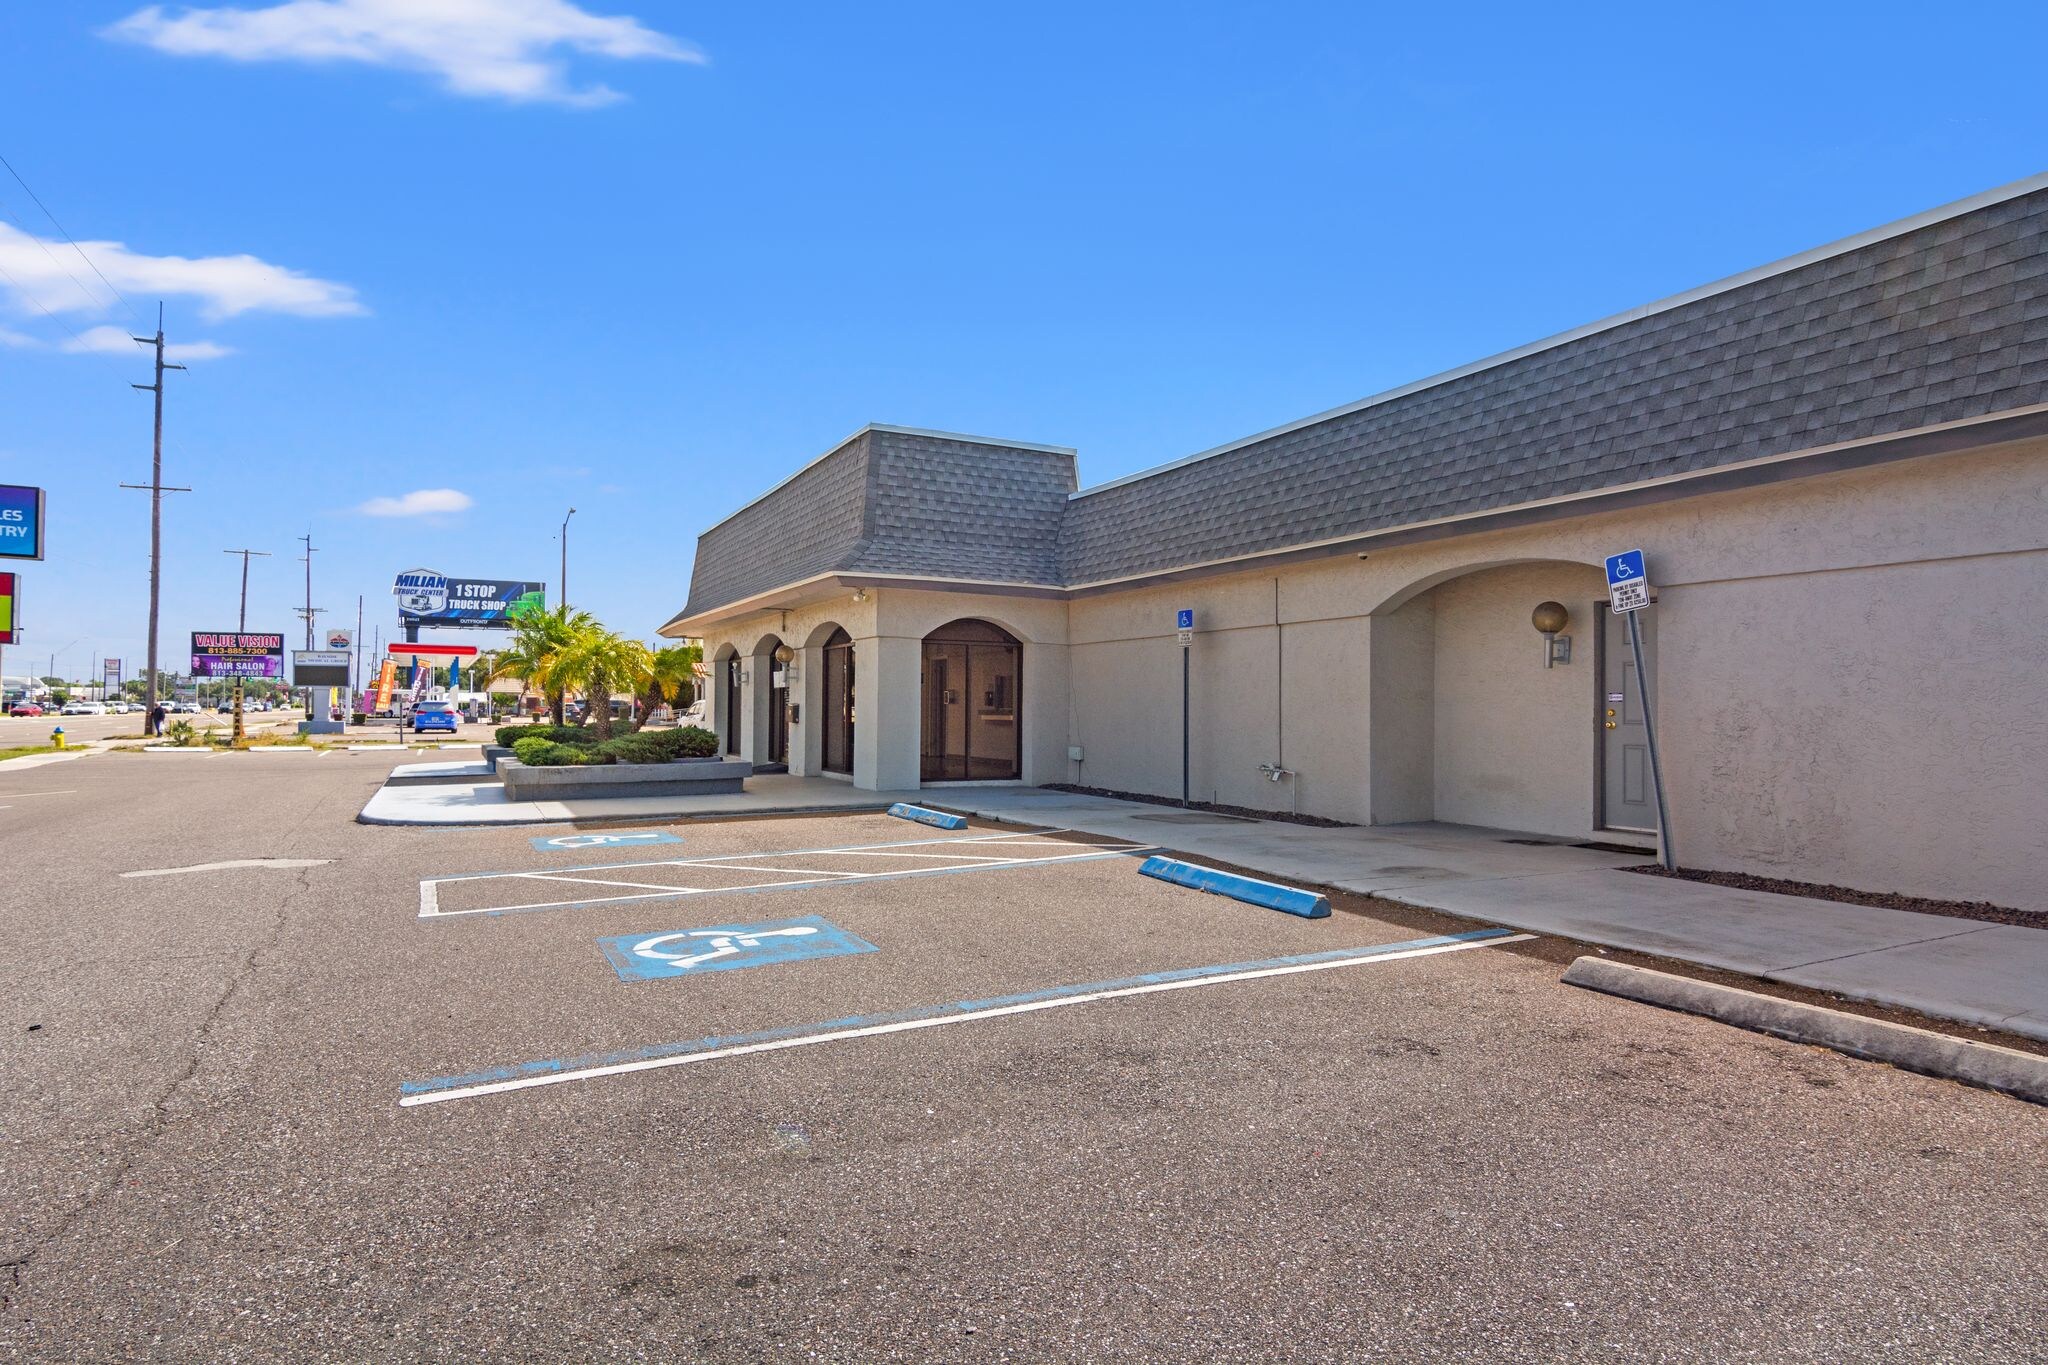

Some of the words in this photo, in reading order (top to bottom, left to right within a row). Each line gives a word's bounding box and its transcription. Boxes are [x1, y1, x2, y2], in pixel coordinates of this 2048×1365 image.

[395, 575, 447, 588] MILIAN
[456, 584, 462, 597] 1
[464, 584, 497, 598] STOP
[449, 599, 479, 610] TRUCK
[481, 600, 507, 611] SHOP
[195, 634, 236, 648] VALUE
[238, 635, 280, 649] VISION
[208, 647, 268, 655] 813-885-7300
[210, 662, 233, 670] HAIR
[235, 662, 265, 670] SALON
[410, 666, 426, 701] TIRES
